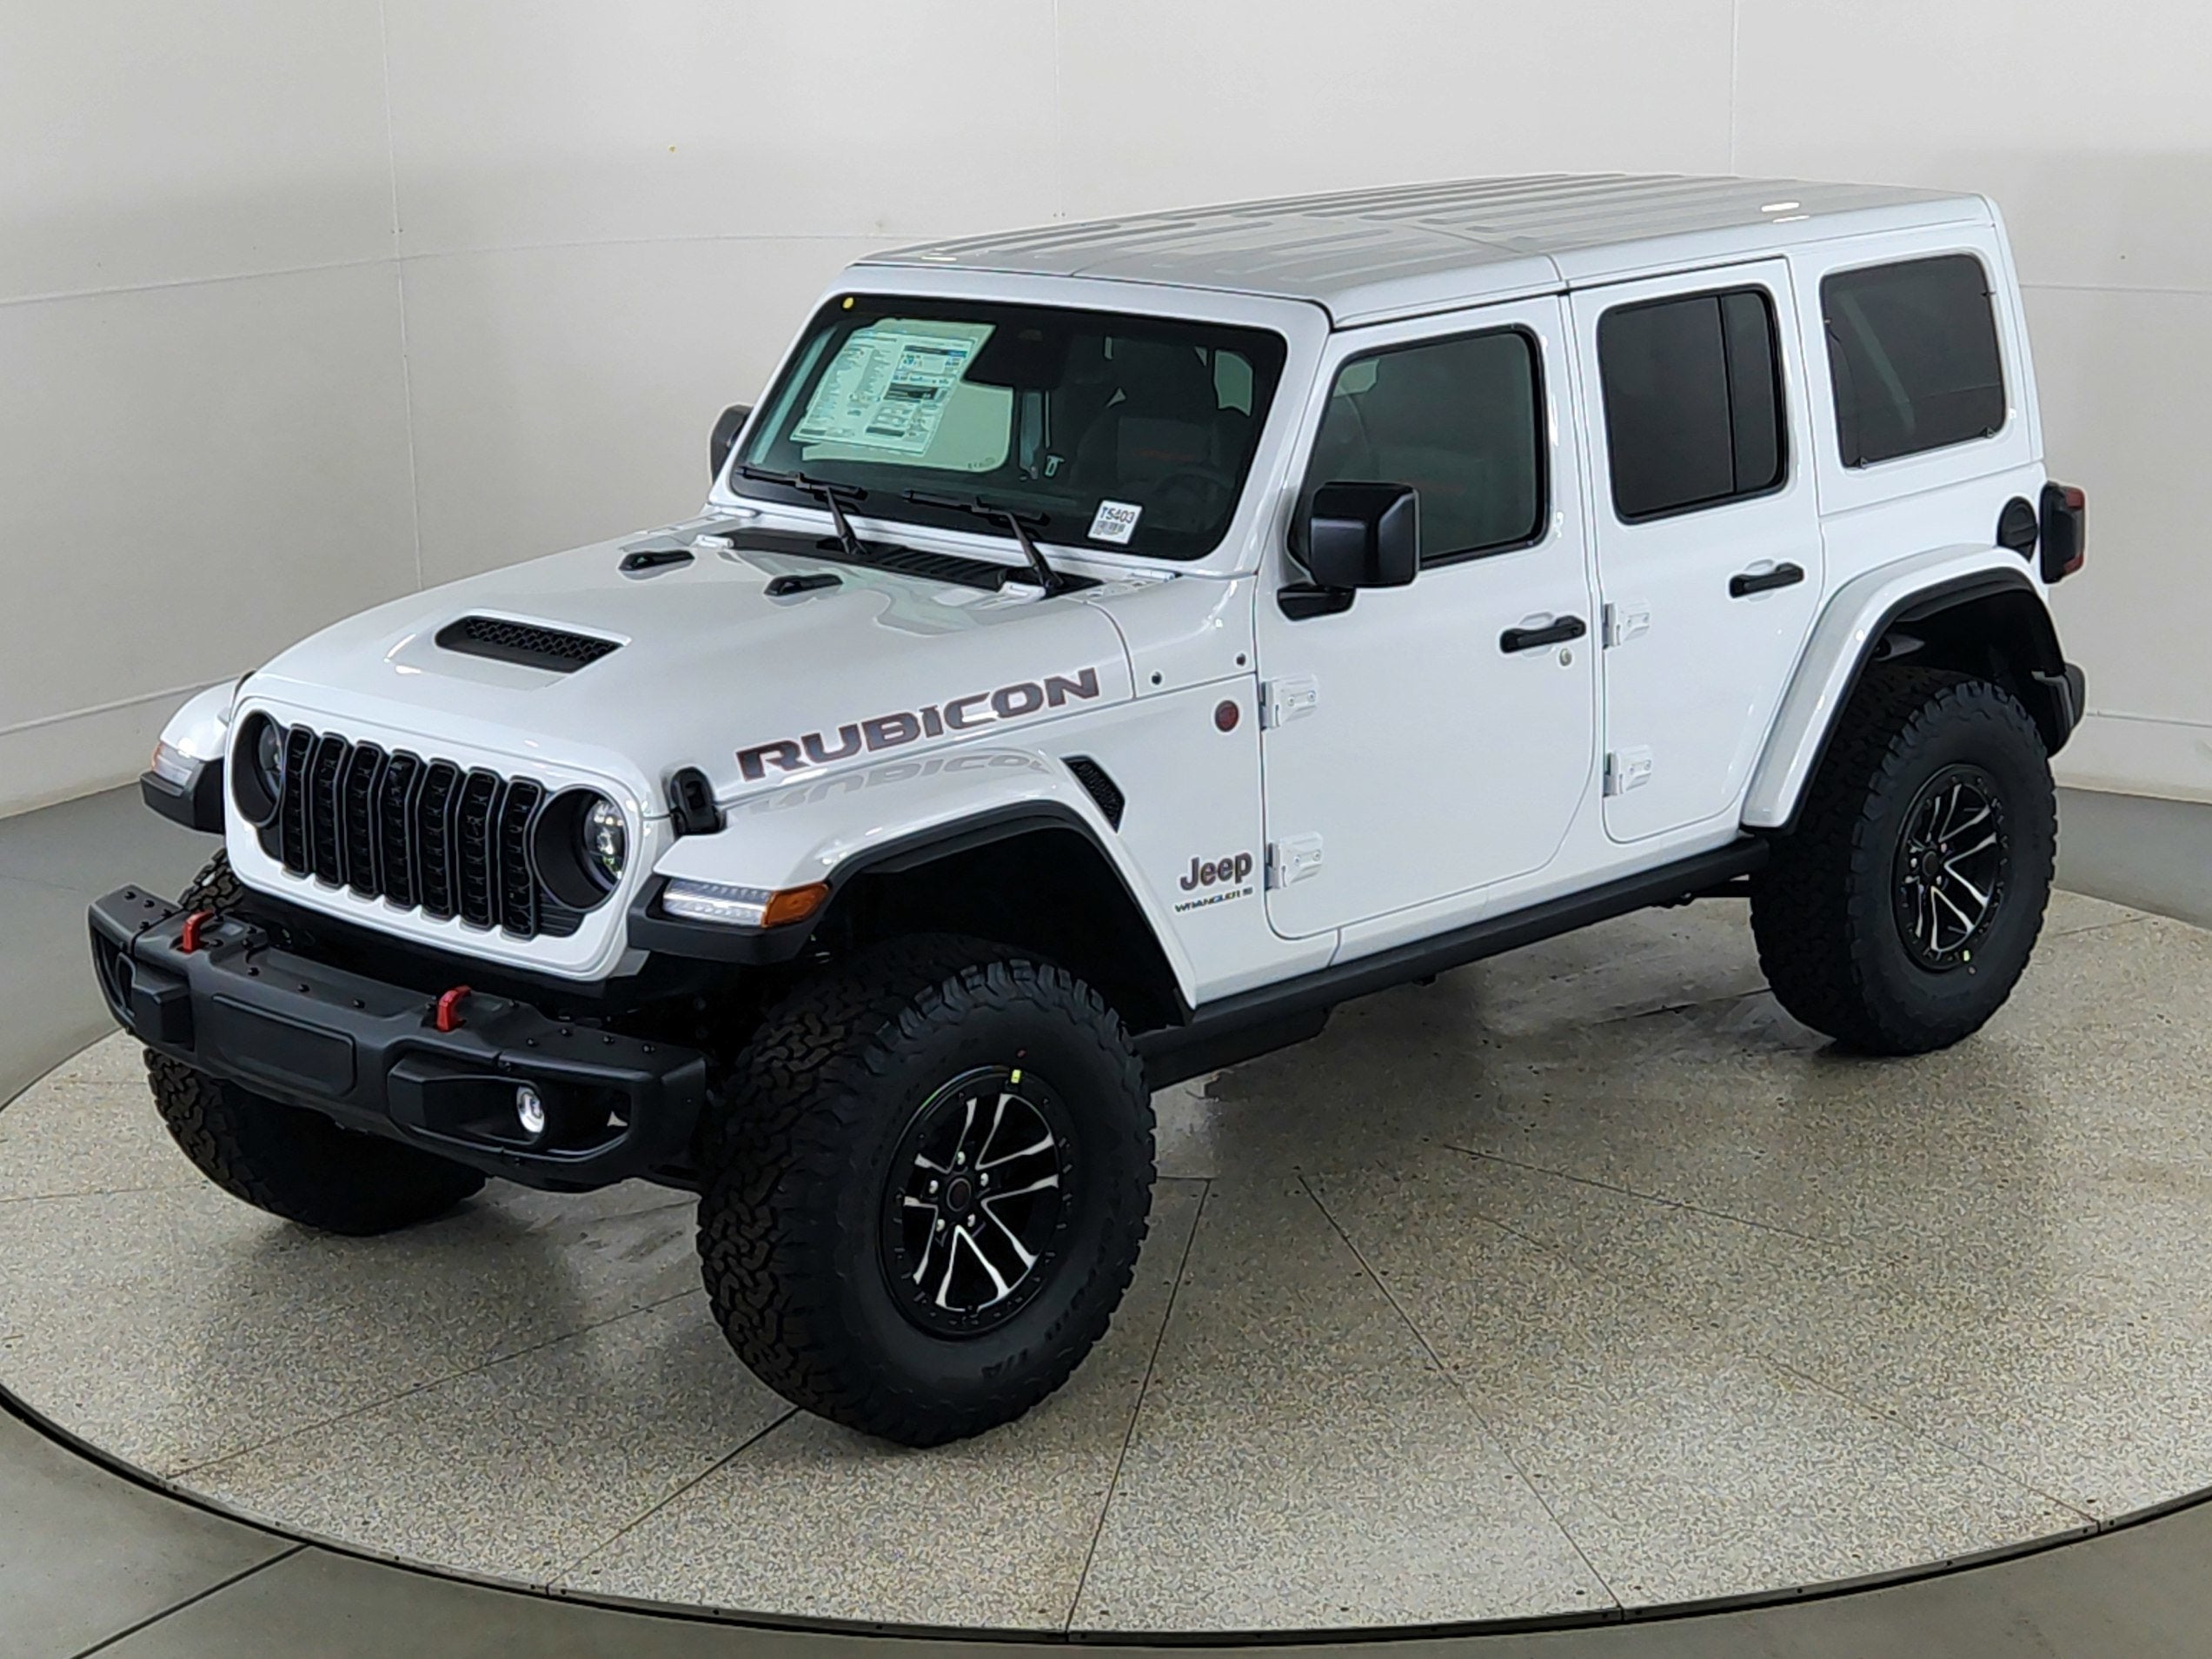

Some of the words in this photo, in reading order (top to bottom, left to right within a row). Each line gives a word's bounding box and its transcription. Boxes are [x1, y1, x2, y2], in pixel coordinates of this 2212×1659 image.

[1099, 507, 1135, 523] T5403
[736, 667, 1099, 782] RUBICON
[1179, 852, 1252, 891] Jeep
